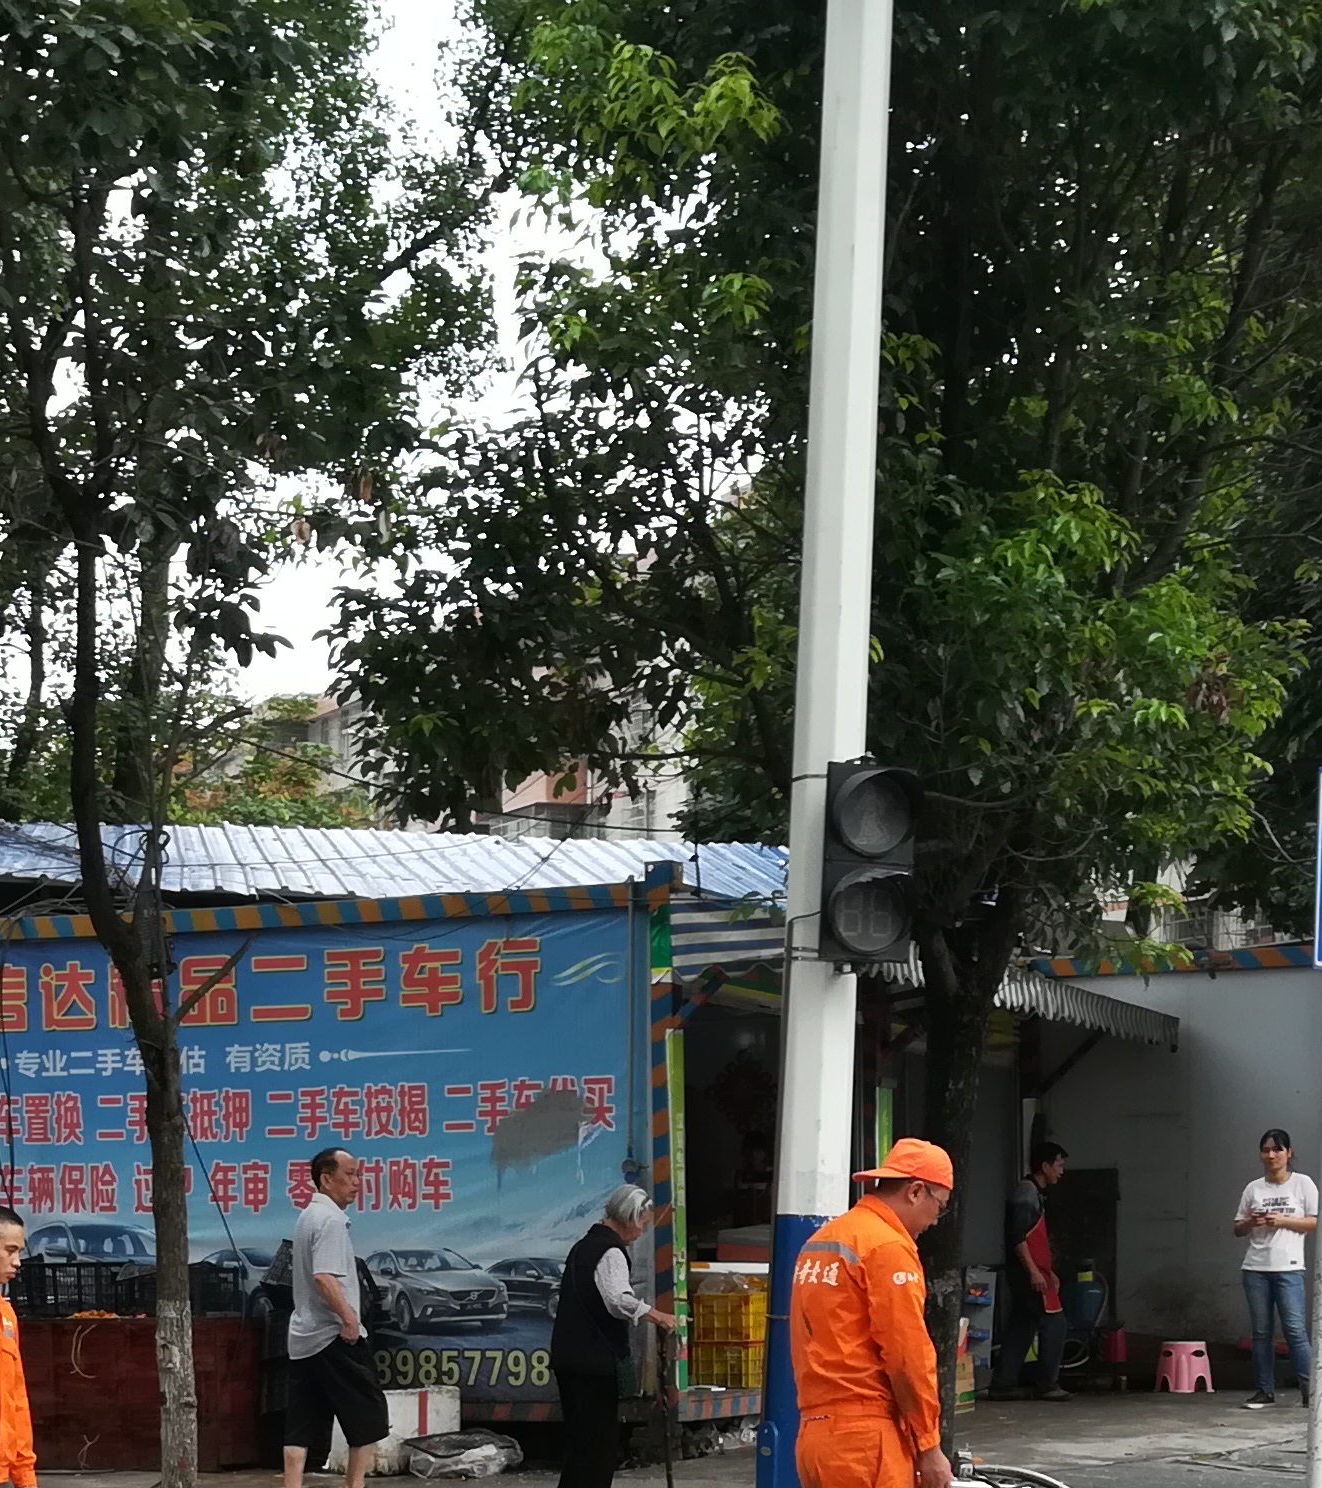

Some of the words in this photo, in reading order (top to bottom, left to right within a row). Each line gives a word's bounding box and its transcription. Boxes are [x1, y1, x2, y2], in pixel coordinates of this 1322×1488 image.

[14, 1045, 206, 1079] 专业二手车估
[225, 1041, 312, 1073] 有资质
[96, 1088, 252, 1145] 二手抵押
[265, 1082, 429, 1141] 二手车按揭
[132, 1160, 194, 1215] 过
[210, 1160, 271, 1214] 年审
[286, 1155, 453, 1212] 零付购车
